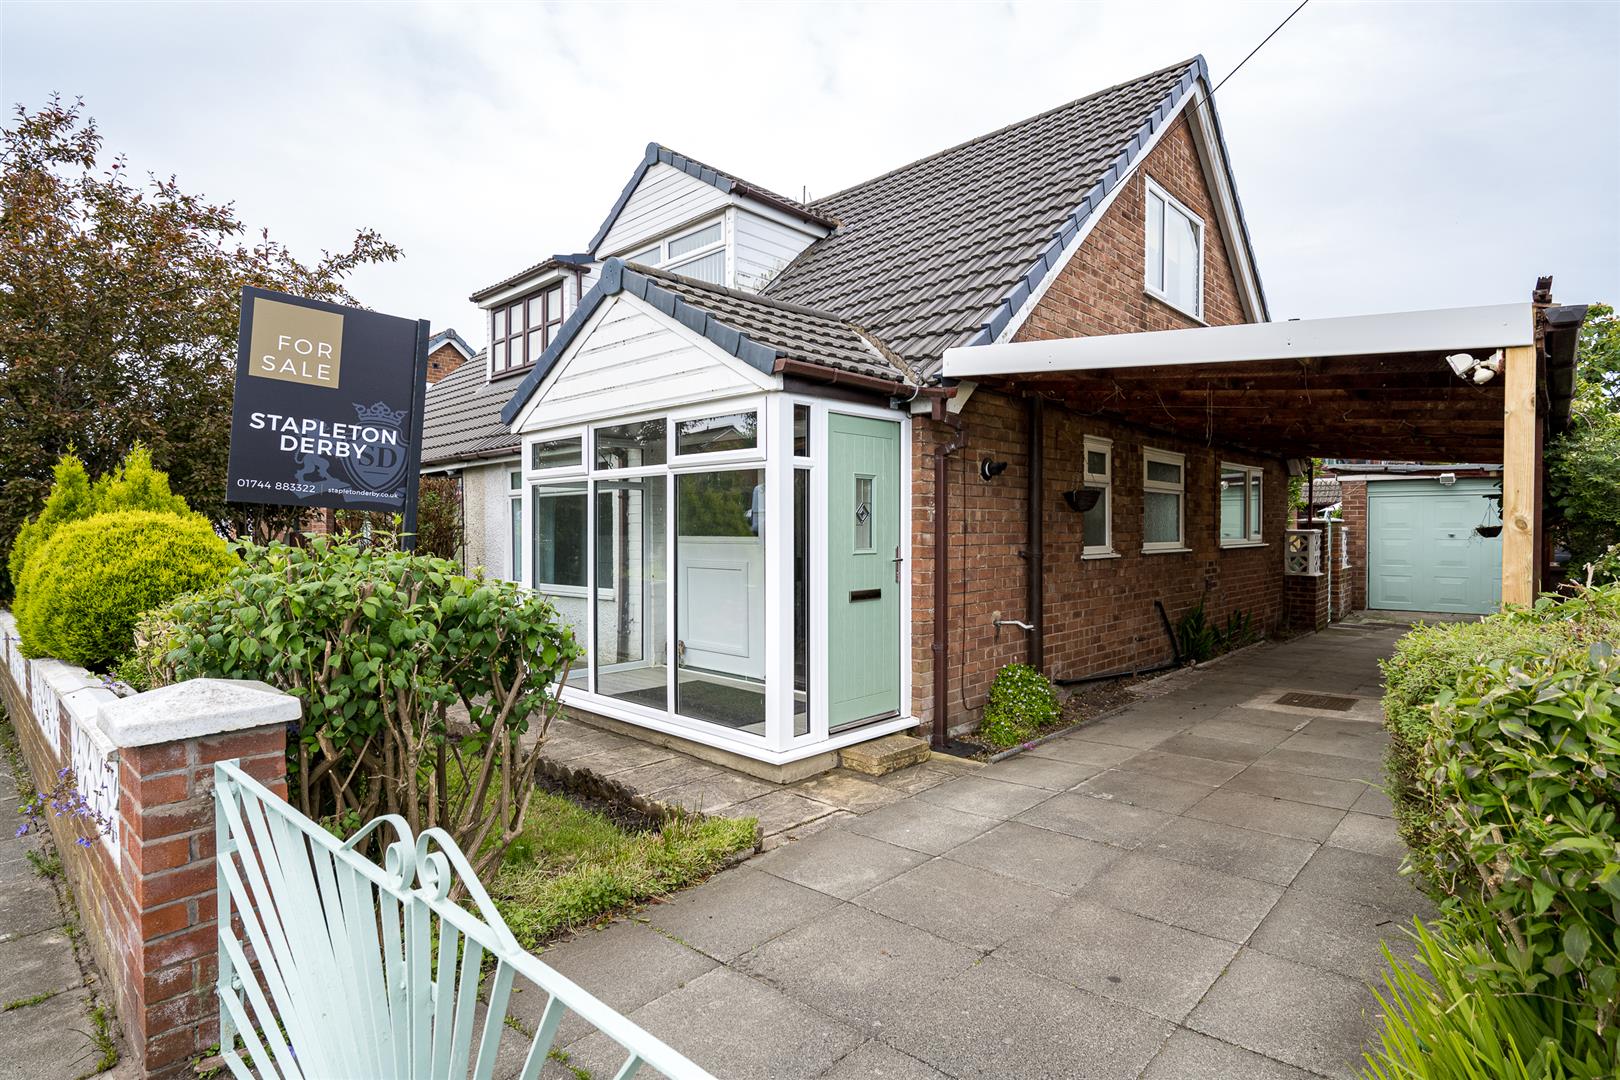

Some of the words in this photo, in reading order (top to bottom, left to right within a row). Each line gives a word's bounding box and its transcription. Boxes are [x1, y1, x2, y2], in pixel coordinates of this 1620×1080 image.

[278, 334, 333, 360] FOR
[261, 355, 331, 381] SALE
[249, 412, 397, 445] STAPLETON
[280, 434, 367, 459] DERBY
[358, 446, 397, 469] SD
[237, 478, 271, 490] 01744
[275, 482, 316, 493] 883322
[327, 487, 398, 499] stapletonderby.co.uk
